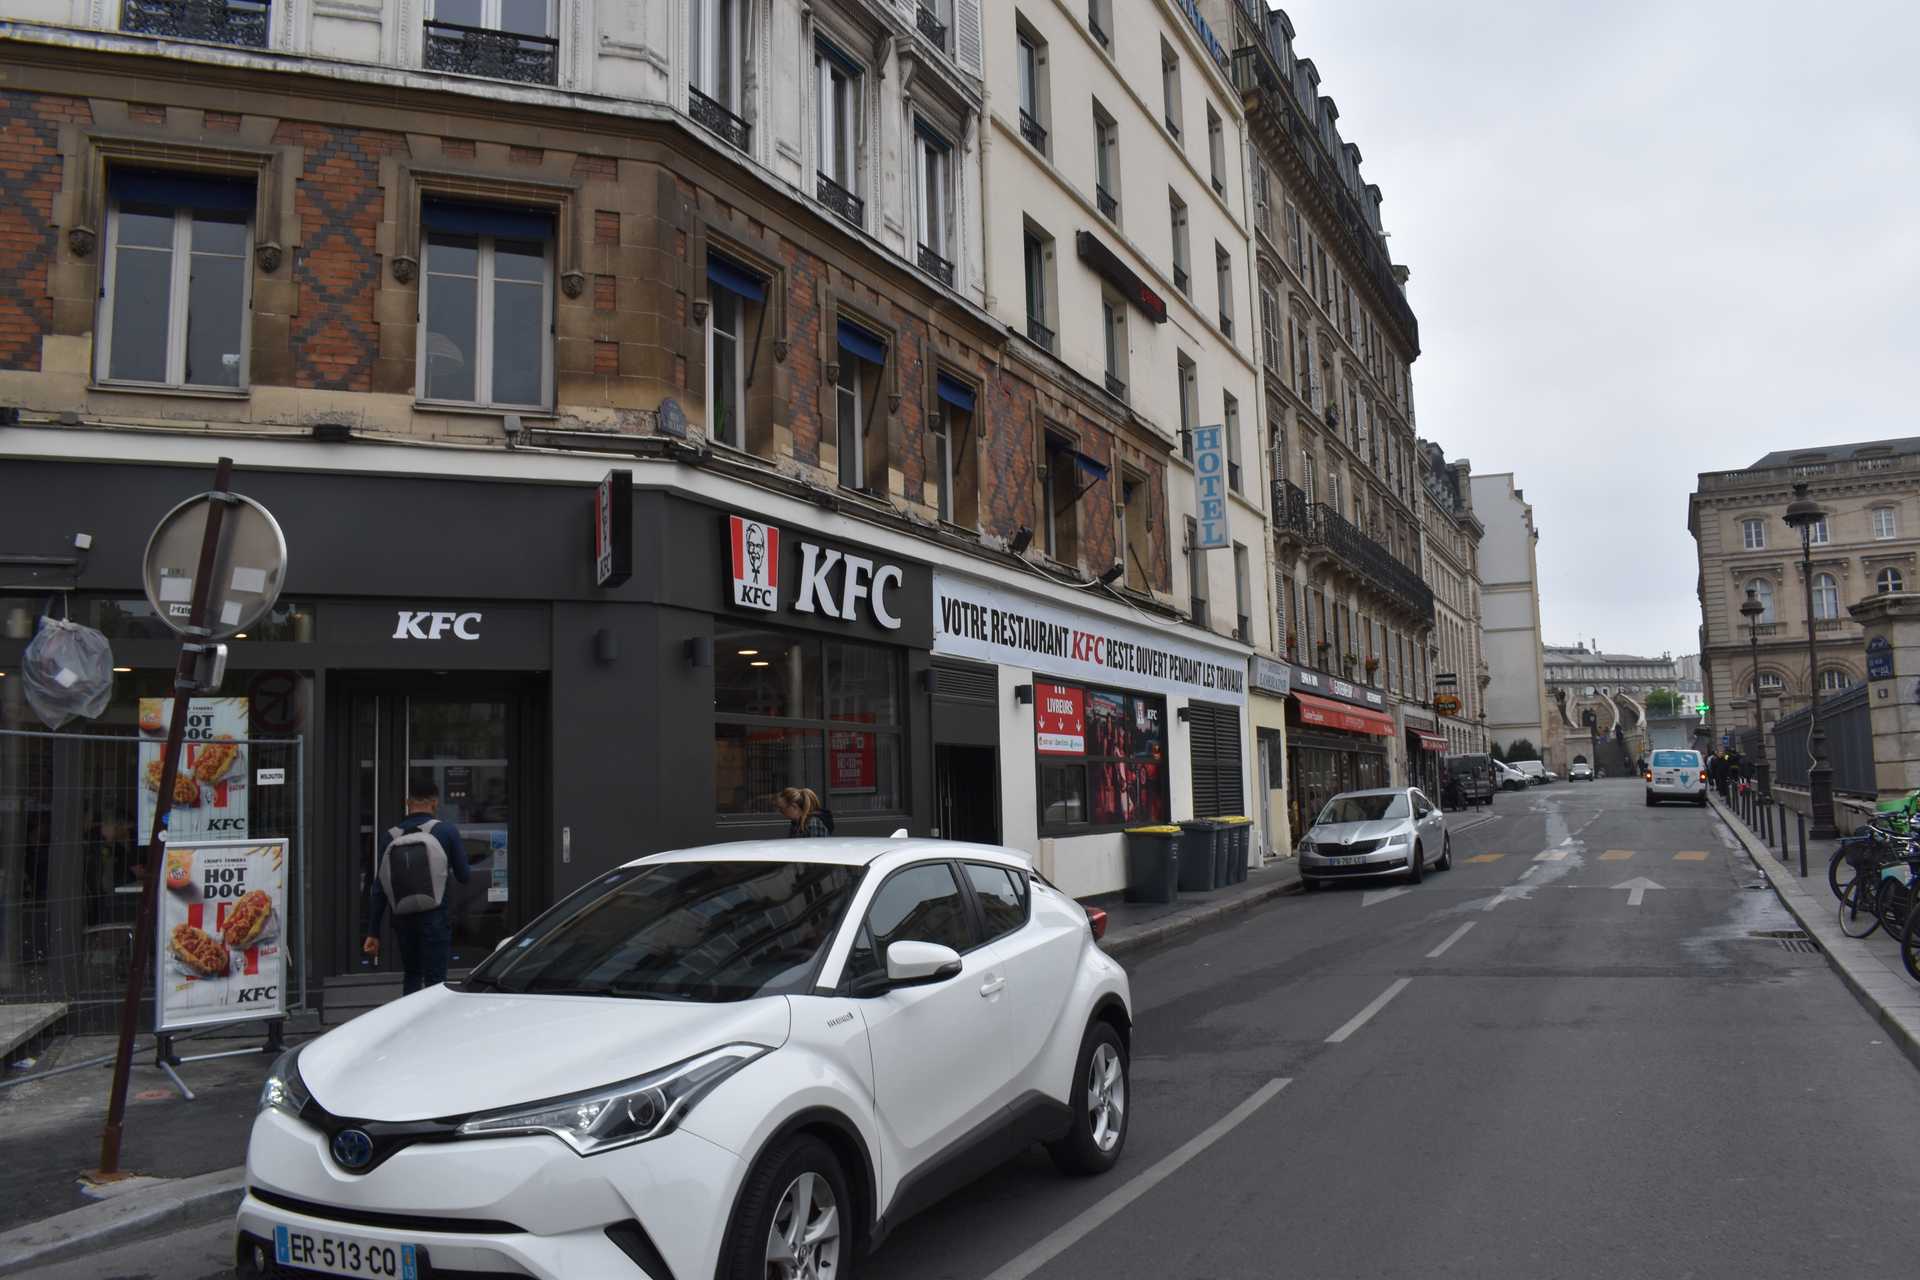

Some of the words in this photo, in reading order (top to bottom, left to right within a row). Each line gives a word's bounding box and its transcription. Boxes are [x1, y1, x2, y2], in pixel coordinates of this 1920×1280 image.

[1195, 427, 1223, 545] HOTEL
[794, 542, 903, 630] KFC
[740, 585, 772, 607] KFC
[392, 611, 482, 640] KFC
[940, 595, 988, 642] VOTRE
[991, 608, 1069, 659] RESTAURANT
[1070, 630, 1105, 665] KFC
[1106, 638, 1134, 673] RESTE
[1136, 645, 1168, 680] OUVERT
[1169, 654, 1201, 686] PENDANT
[1202, 662, 1215, 689] LES
[1216, 665, 1244, 694] TRAVAUX
[185, 714, 214, 728] OT
[1147, 708, 1158, 721] KFC
[207, 817, 246, 832] KFC
[204, 867, 248, 884] HOT
[203, 883, 247, 900] DOG
[236, 985, 278, 1004] KFC
